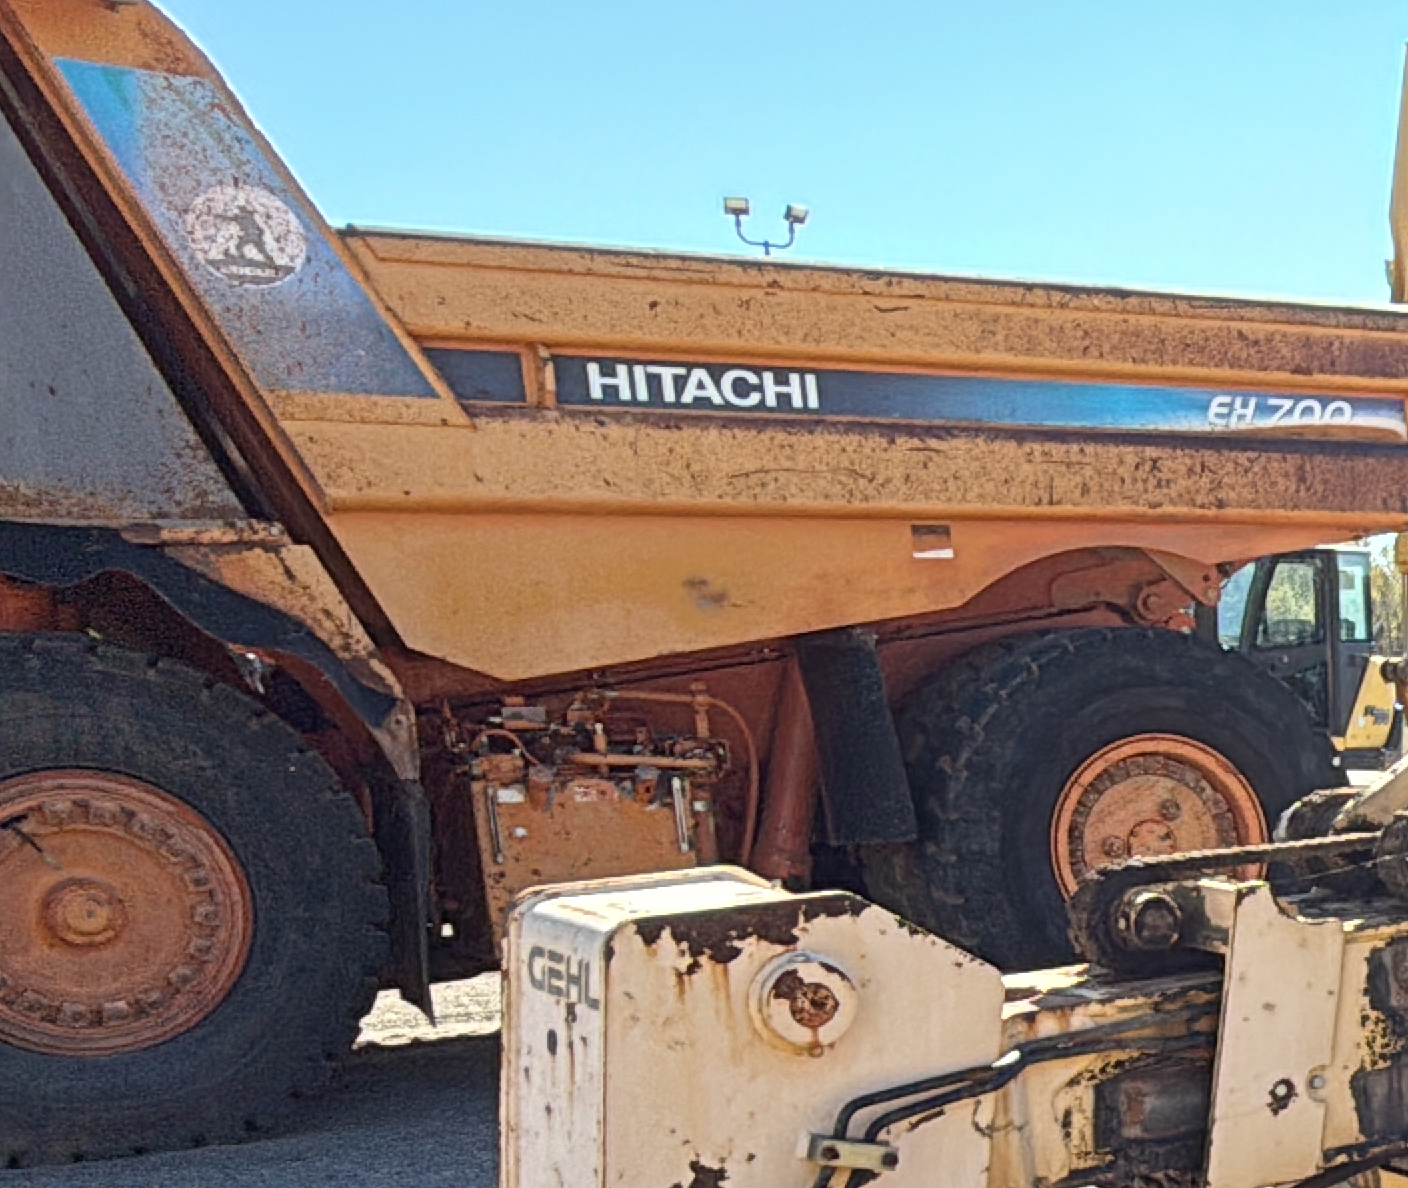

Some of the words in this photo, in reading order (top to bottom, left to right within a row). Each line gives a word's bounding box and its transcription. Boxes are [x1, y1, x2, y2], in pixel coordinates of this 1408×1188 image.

[586, 361, 820, 410] HITACHI
[1207, 395, 1257, 428] EH
[527, 945, 600, 1012] GEHL
